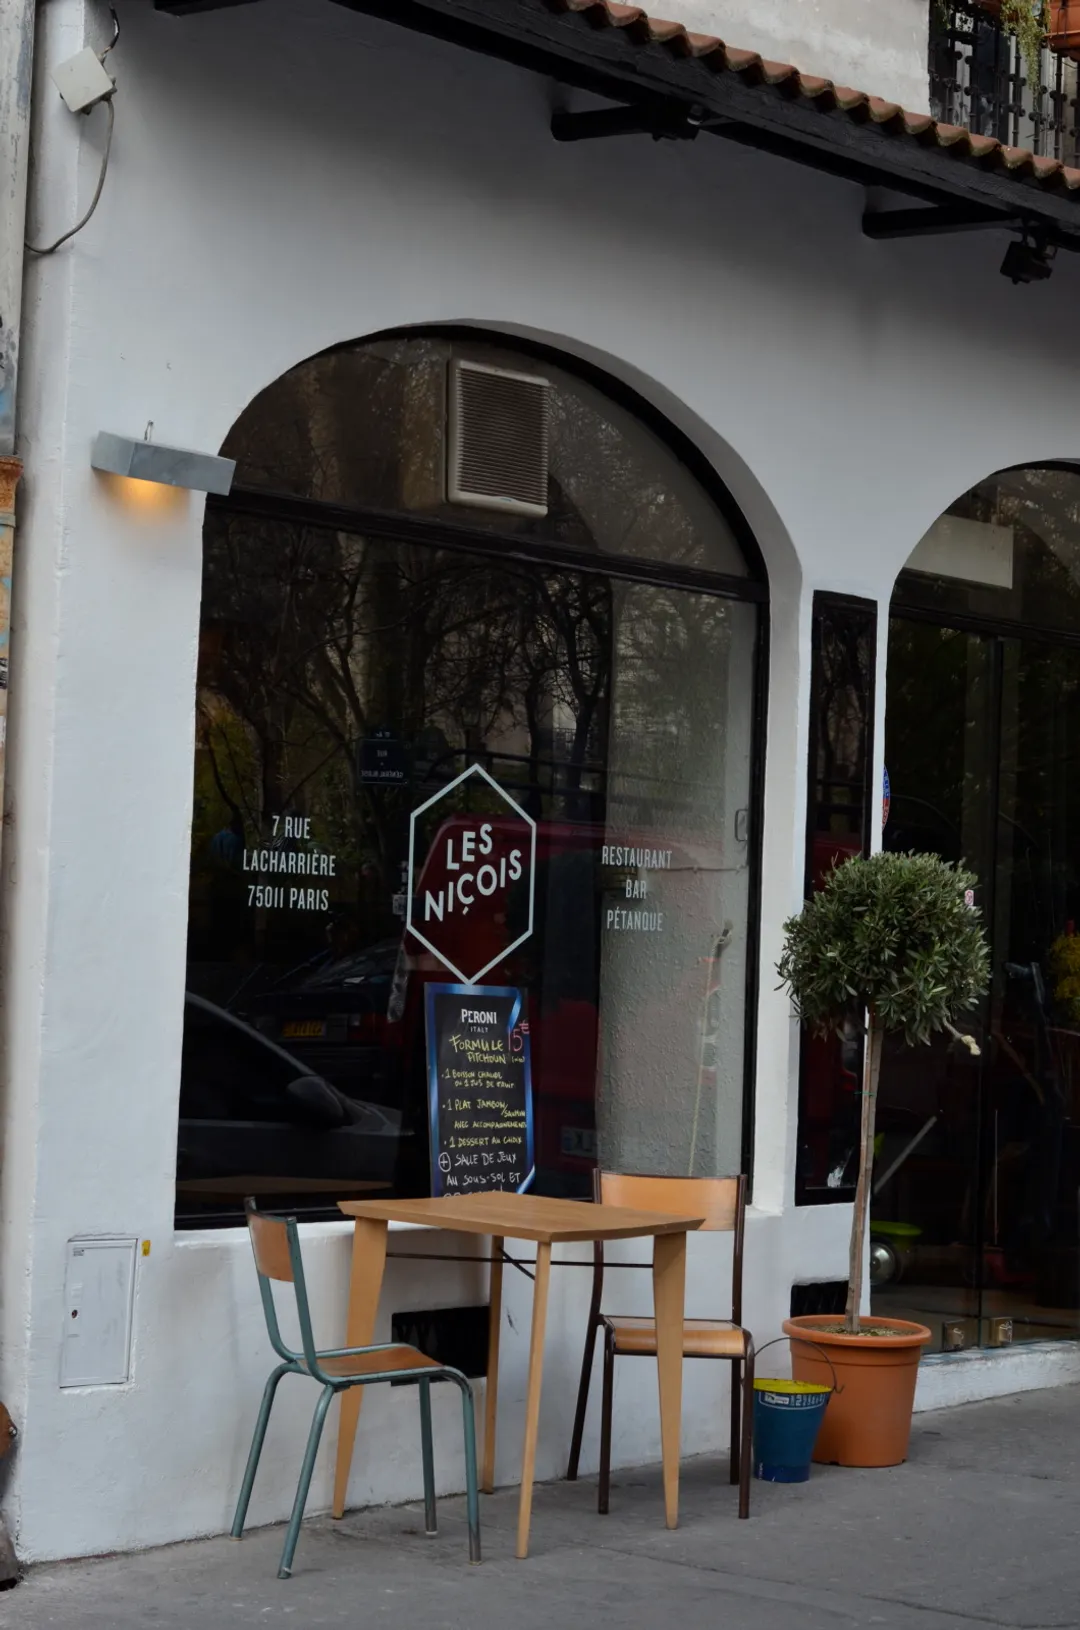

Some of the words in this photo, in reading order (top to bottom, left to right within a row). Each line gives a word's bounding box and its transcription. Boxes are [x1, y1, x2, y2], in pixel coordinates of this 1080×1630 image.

[272, 815, 280, 836] 7
[285, 816, 311, 839] RUE
[446, 823, 493, 870] LES
[243, 849, 336, 876] LACHARRIÈRE
[602, 845, 672, 869] RESTAURANT
[424, 849, 522, 922] NIÇOIS
[625, 879, 647, 899] BAR
[248, 885, 284, 908] 75011
[289, 888, 329, 911] PARIS
[606, 906, 663, 931] PÉTANQUE
[461, 1008, 497, 1024] PERONI
[449, 1034, 503, 1052] FORMULE
[452, 1069, 475, 1079] BOISSON
[454, 1099, 471, 1110] PLAT
[454, 1120, 469, 1129] AVEC
[458, 1137, 489, 1147] DESSERT
[454, 1154, 479, 1166] SALLE
[481, 1153, 494, 1165] DE
[497, 1151, 517, 1163] JEUX
[446, 1174, 458, 1186] AU
[462, 1172, 505, 1185] SOUS-SOL
[509, 1172, 520, 1183] ET
